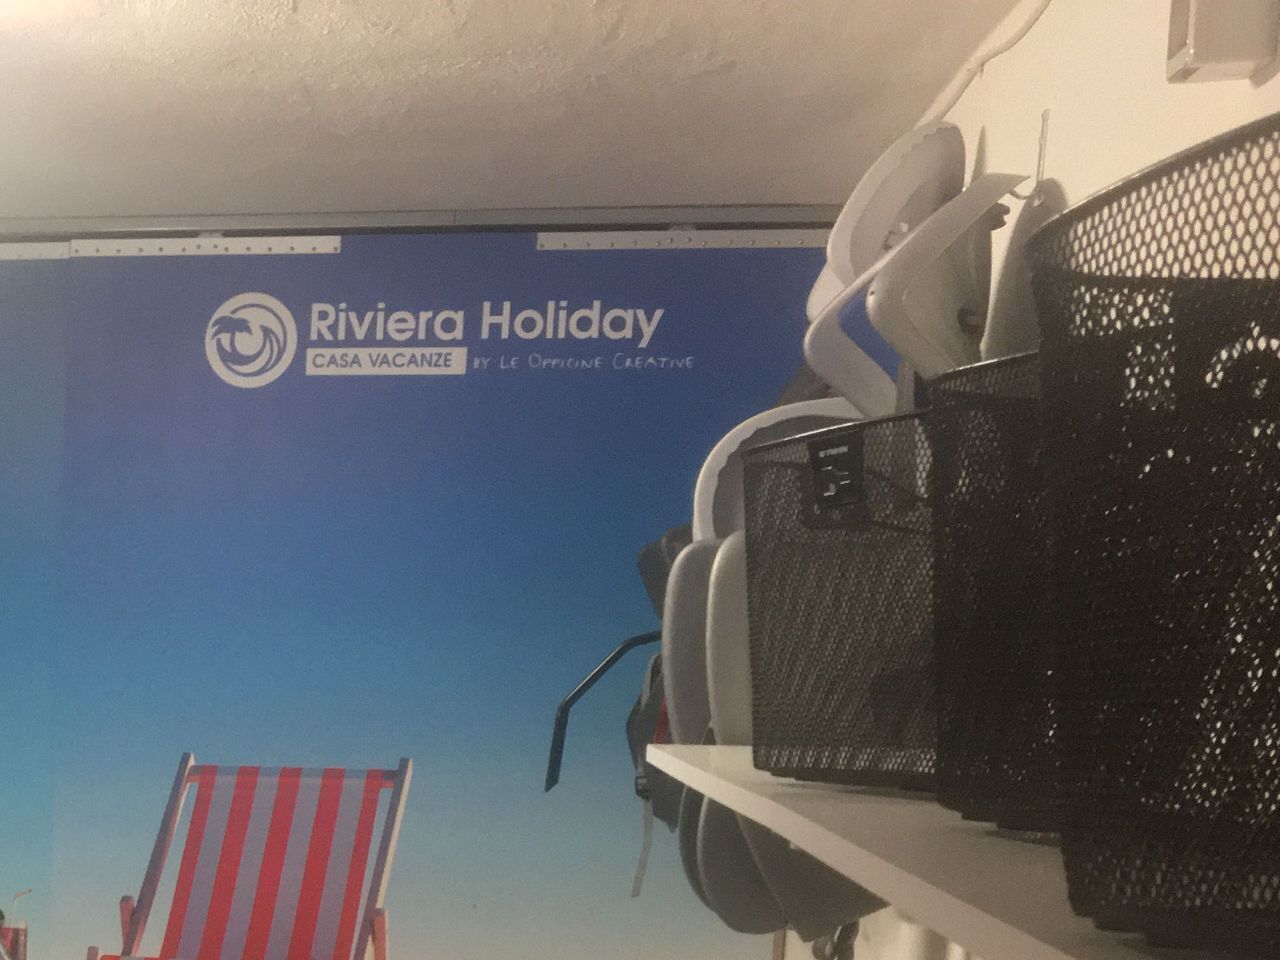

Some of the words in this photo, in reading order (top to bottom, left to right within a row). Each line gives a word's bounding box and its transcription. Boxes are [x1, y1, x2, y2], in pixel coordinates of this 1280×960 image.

[310, 302, 465, 342] Riviera
[481, 300, 665, 349] Holiday
[312, 352, 363, 369] CASA
[368, 352, 453, 369] VACANZE
[473, 357, 491, 370] BY
[500, 356, 520, 370] LE
[613, 352, 695, 370] CREATIVE
